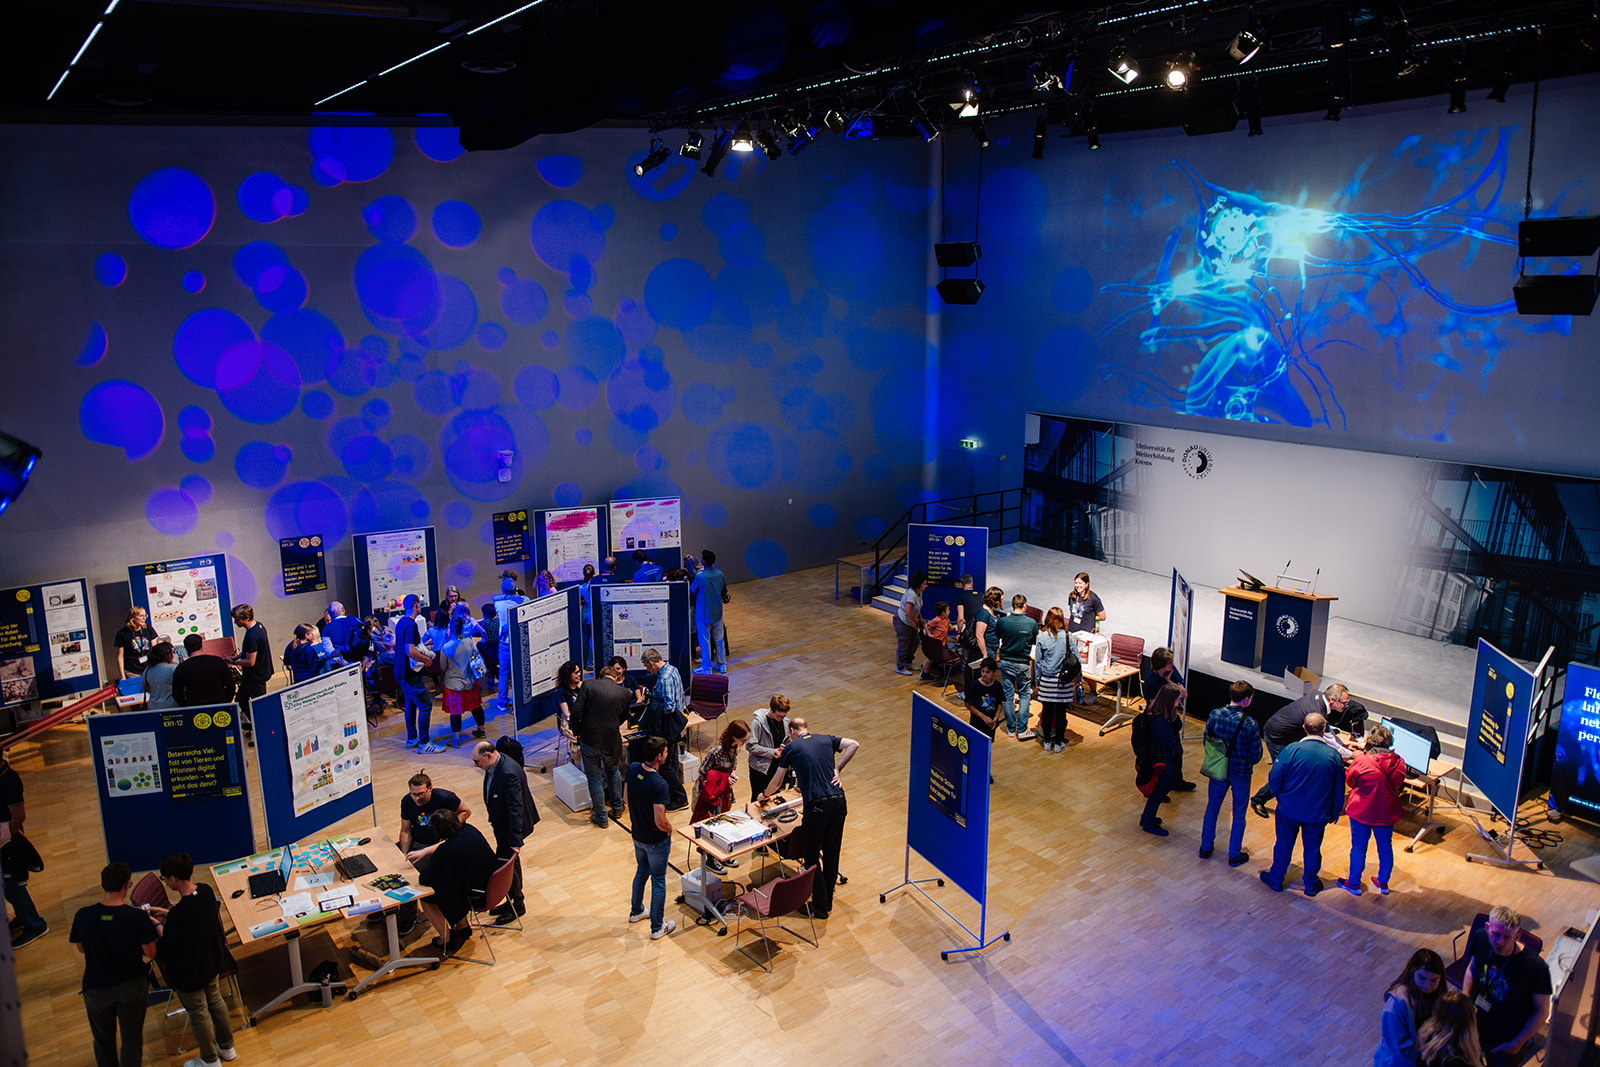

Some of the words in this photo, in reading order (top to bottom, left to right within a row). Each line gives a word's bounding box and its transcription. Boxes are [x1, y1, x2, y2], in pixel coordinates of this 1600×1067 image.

[1136, 443, 1166, 452] Universität
[1135, 451, 1175, 462] Weiterbildung
[1182, 445, 1198, 462] DONAU
[1578, 730, 1600, 743] per
[167, 749, 202, 758] Österreichs
[197, 764, 216, 772] digital
[170, 774, 199, 782] erkunden
[171, 783, 186, 792] geht
[199, 780, 217, 788] denn?
